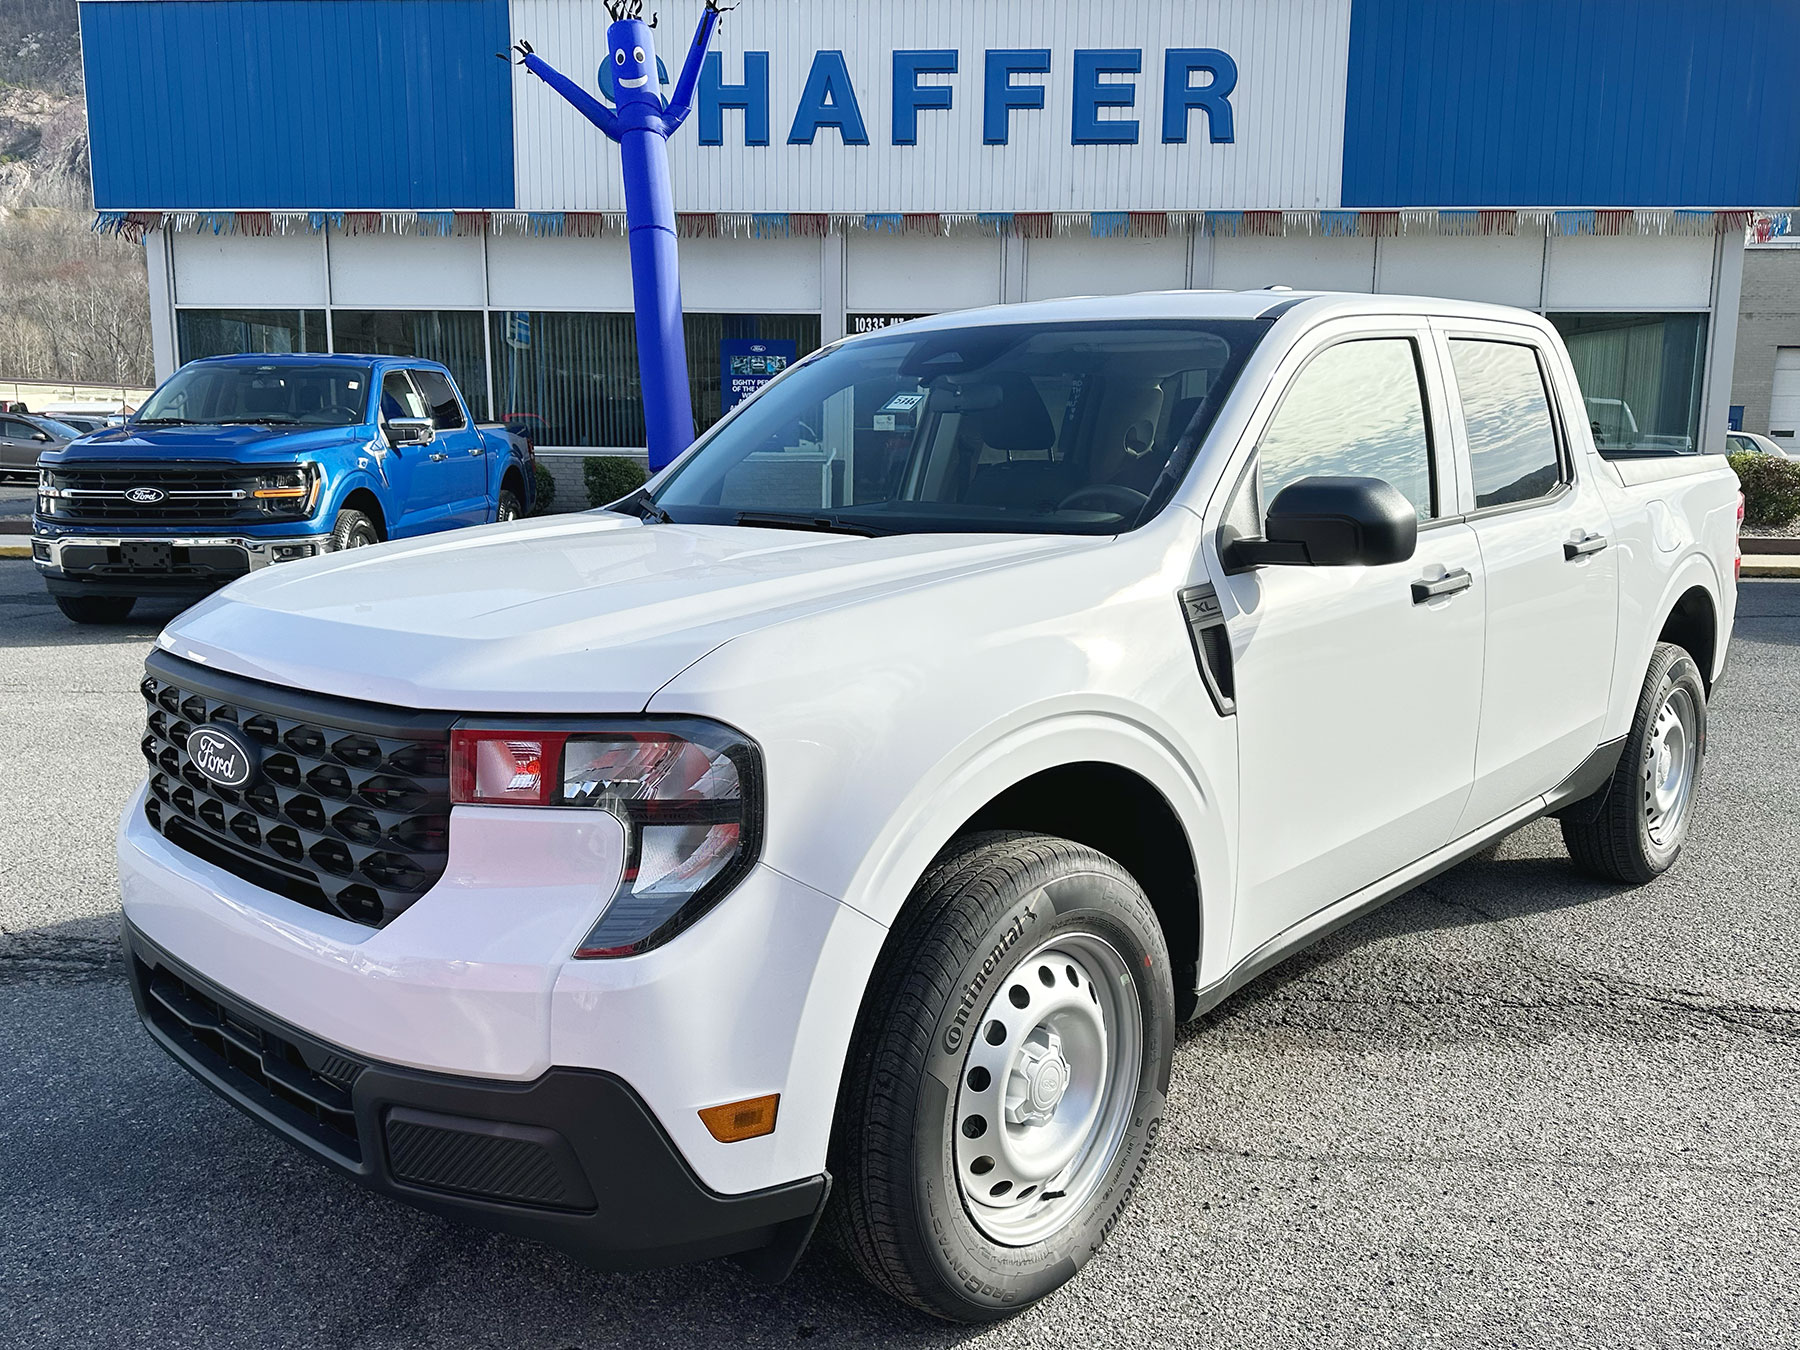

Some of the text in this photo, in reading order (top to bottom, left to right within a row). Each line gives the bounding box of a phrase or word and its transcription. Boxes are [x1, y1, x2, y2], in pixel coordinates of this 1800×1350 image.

[131, 489, 157, 501] Ford
[1192, 601, 1217, 615] XL
[196, 734, 237, 780] Ford
[942, 915, 1025, 1056] Continental
